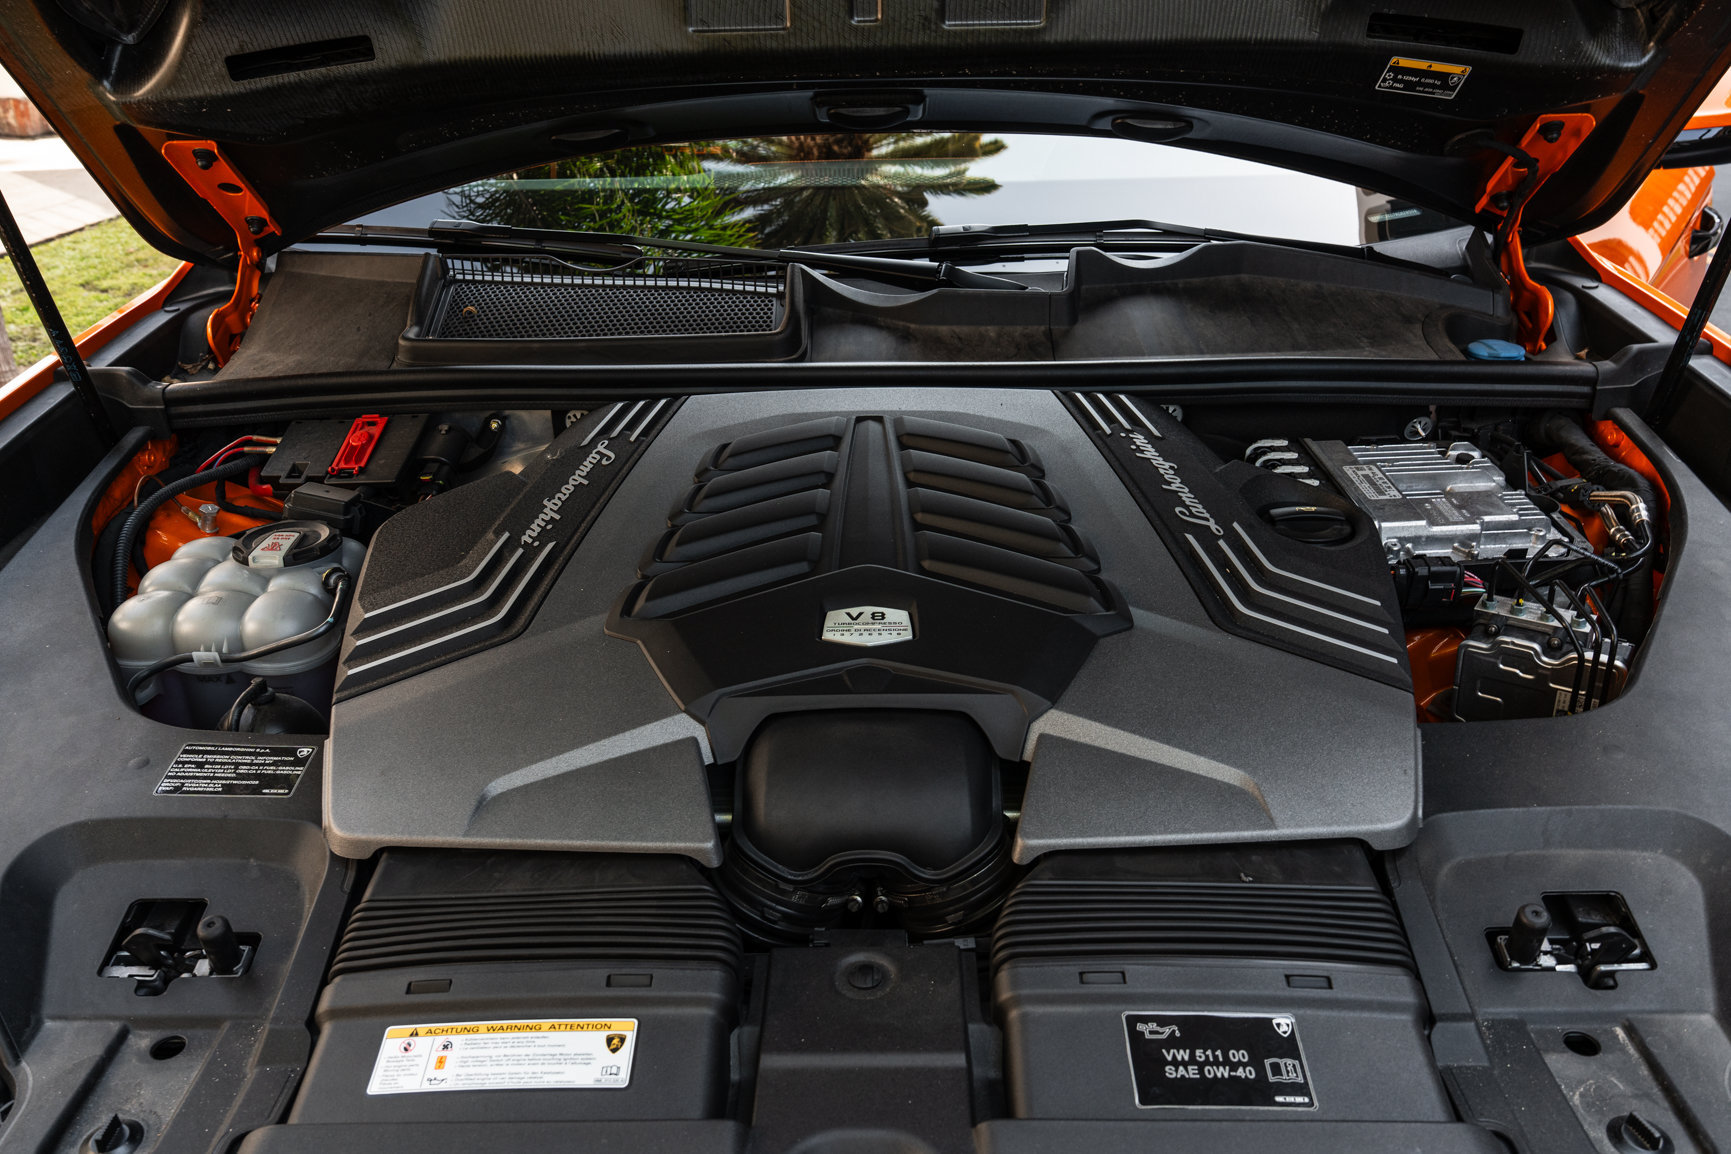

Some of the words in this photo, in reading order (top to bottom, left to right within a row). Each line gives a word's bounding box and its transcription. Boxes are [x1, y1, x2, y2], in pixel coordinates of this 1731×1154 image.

[1120, 432, 1224, 535] Lamborghini
[521, 440, 615, 547] Lamborghini
[425, 1025, 480, 1036] ACHTUNG
[486, 1023, 542, 1032] WARNING
[548, 1022, 612, 1031] ATTENTION
[1162, 1049, 1190, 1062] VW
[1195, 1049, 1223, 1062] 511
[1229, 1050, 1249, 1062] 00
[1165, 1066, 1200, 1078] SAE
[1204, 1066, 1256, 1079] 0W-40
